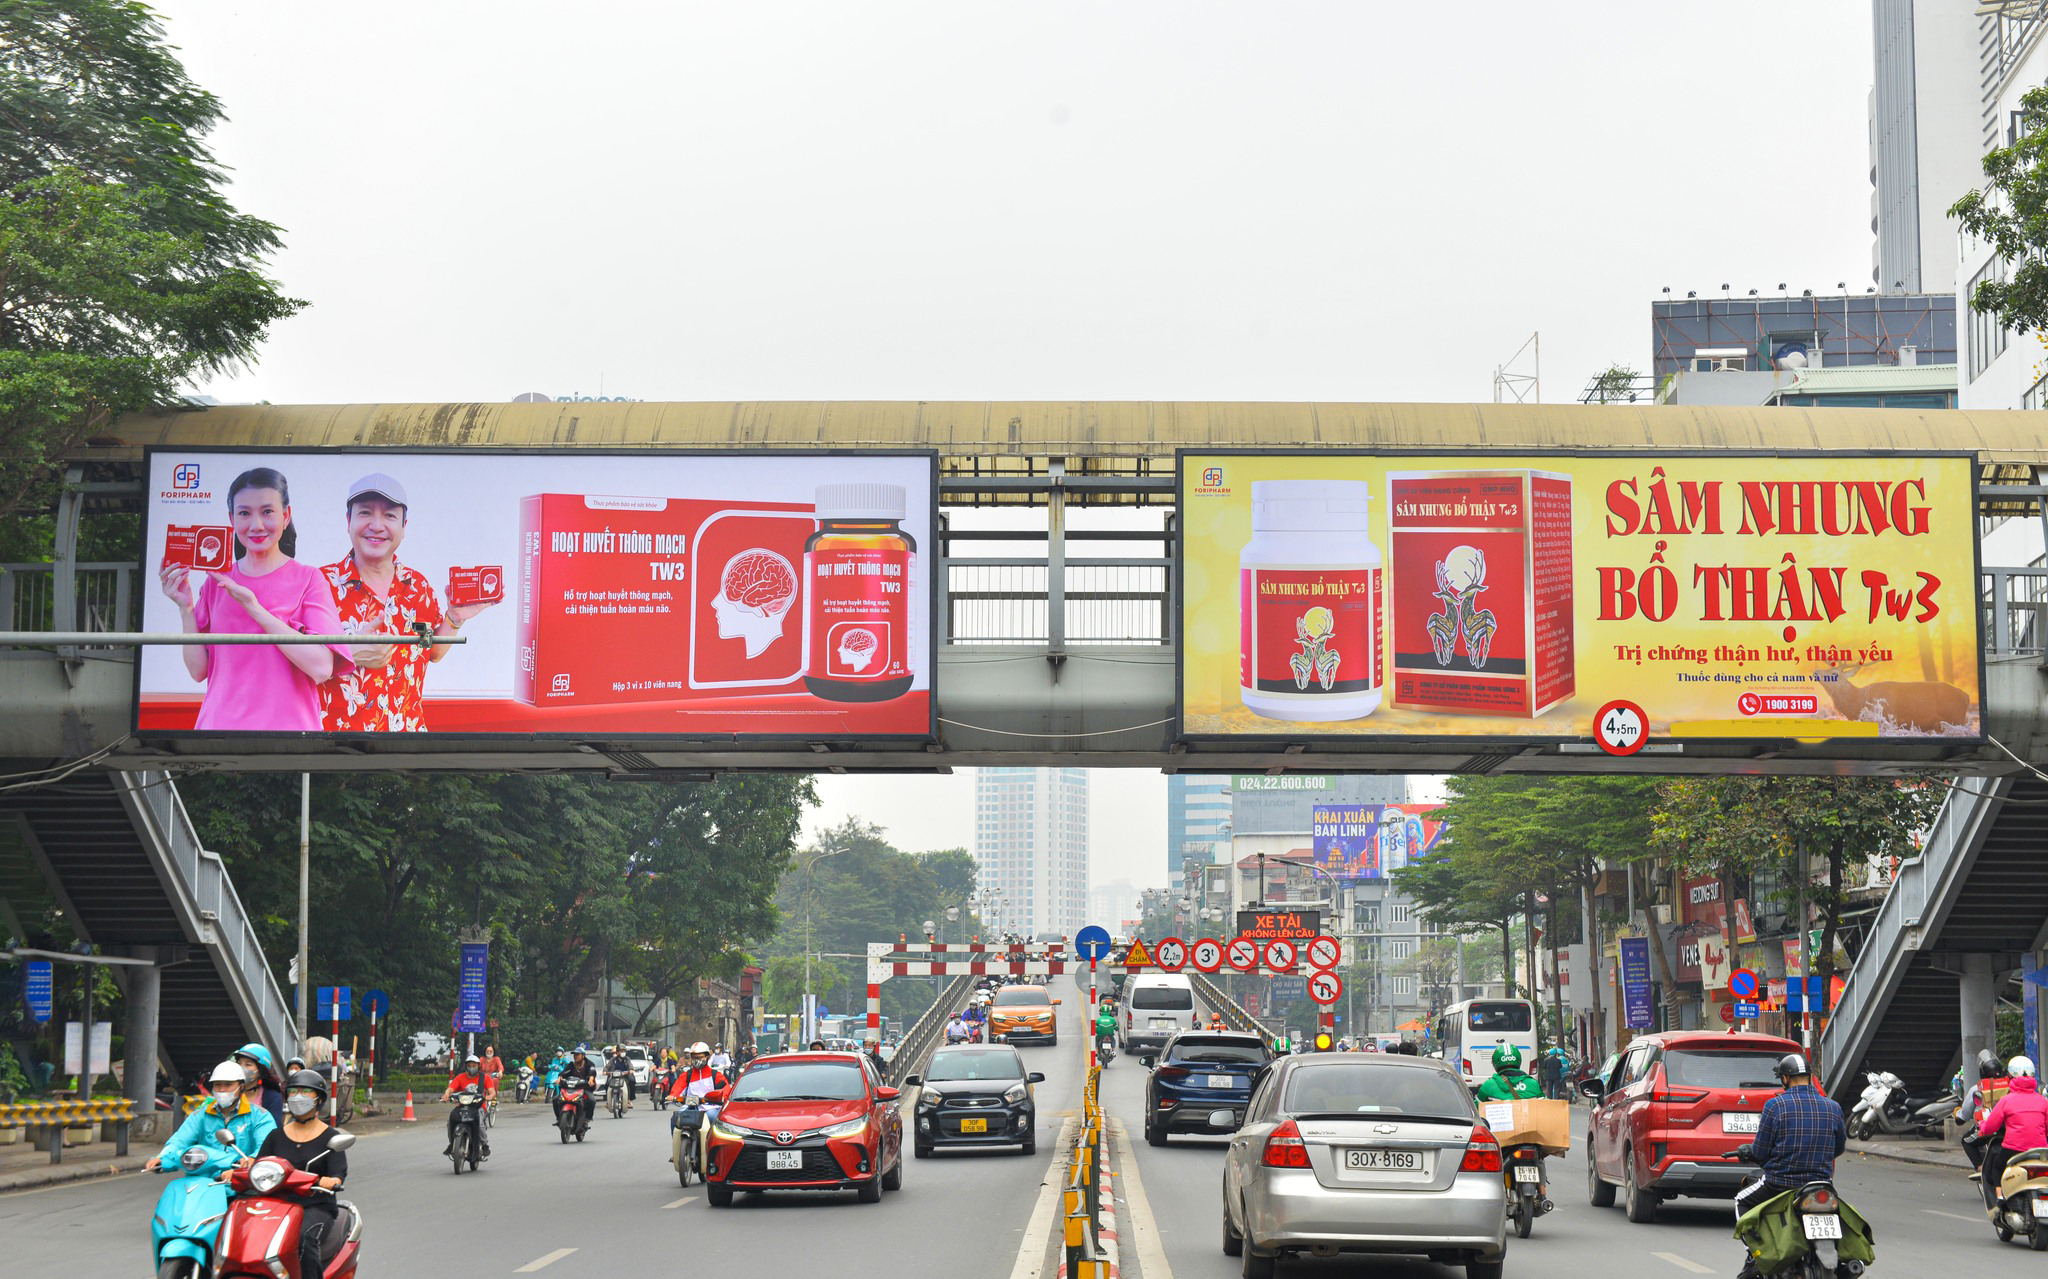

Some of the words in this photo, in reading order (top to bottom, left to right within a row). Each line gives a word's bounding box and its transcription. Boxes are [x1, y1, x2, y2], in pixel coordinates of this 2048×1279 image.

[1396, 500, 1417, 517] SÂM
[1419, 503, 1452, 517] NHUNG
[1454, 496, 1468, 516] BỔ
[1470, 500, 1496, 521] THẬN
[1605, 466, 1723, 538] SÂM
[1737, 477, 1933, 537] NHUNG
[551, 532, 580, 558] HOẠT
[583, 525, 616, 553] HUYẾT
[619, 530, 652, 554] THÔNG
[655, 534, 686, 558] MẠCH
[650, 562, 685, 580] TW3
[818, 564, 832, 578] HOẠT
[834, 559, 855, 575] HUYẾT
[857, 561, 880, 576] THÔNG
[883, 564, 900, 578] MẠCH
[564, 588, 574, 600] Hỗ
[576, 591, 588, 602] trợ
[590, 590, 606, 602] hoạt
[608, 588, 628, 602] huyết
[630, 590, 650, 602] thông
[652, 590, 673, 602] mạch,
[880, 582, 900, 593] TW3
[1260, 578, 1277, 595] SÂM
[1278, 584, 1309, 595] NHUNG
[1311, 576, 1324, 595] BỔ
[1326, 579, 1350, 600] THẬN
[1596, 539, 1679, 622] BỔ
[1693, 551, 1848, 642] THẬN
[565, 604, 577, 614] cải
[579, 604, 598, 616] thiện
[600, 602, 616, 614] tuần
[618, 604, 636, 614] hoàn
[638, 604, 654, 613] máu
[656, 604, 671, 613] não.
[1614, 644, 1642, 666] Trị
[1648, 644, 1708, 665] chứng
[1714, 644, 1760, 667] thận
[1767, 646, 1800, 664] hư,
[1806, 644, 1853, 667] thận
[1859, 639, 1893, 665] yếu
[1676, 670, 1711, 683] Thuốc
[1714, 672, 1741, 684] dùng
[1744, 672, 1764, 683] cho
[1766, 671, 1779, 683] cả
[1782, 674, 1806, 682] nam
[1809, 672, 1821, 682] và
[1823, 671, 1839, 682] nữ
[612, 682, 625, 692] Hộp
[627, 681, 631, 690] 3
[644, 681, 651, 689] 10
[653, 680, 665, 688] viên
[667, 681, 682, 689] nang
[1766, 700, 1788, 710] 1900
[1790, 700, 1813, 710] 3199
[1606, 717, 1637, 734] 4,5m
[1240, 777, 1326, 790] 024.22.600.600
[1314, 811, 1340, 824] KHAI
[1344, 808, 1374, 823] XUÂN
[1256, 916, 1274, 928] XE
[1277, 912, 1300, 928] TẢI
[1242, 929, 1276, 938] KHÔNG
[1278, 928, 1294, 938] LÊN
[1296, 927, 1315, 938] CẦU
[1201, 948, 1214, 963] 3t
[1734, 1114, 1750, 1122] 89A
[778, 1152, 792, 1160] 15A
[1351, 1152, 1413, 1167] 30X-8169
[771, 1160, 798, 1168] 988.45
[1811, 1227, 1836, 1237] 2262
